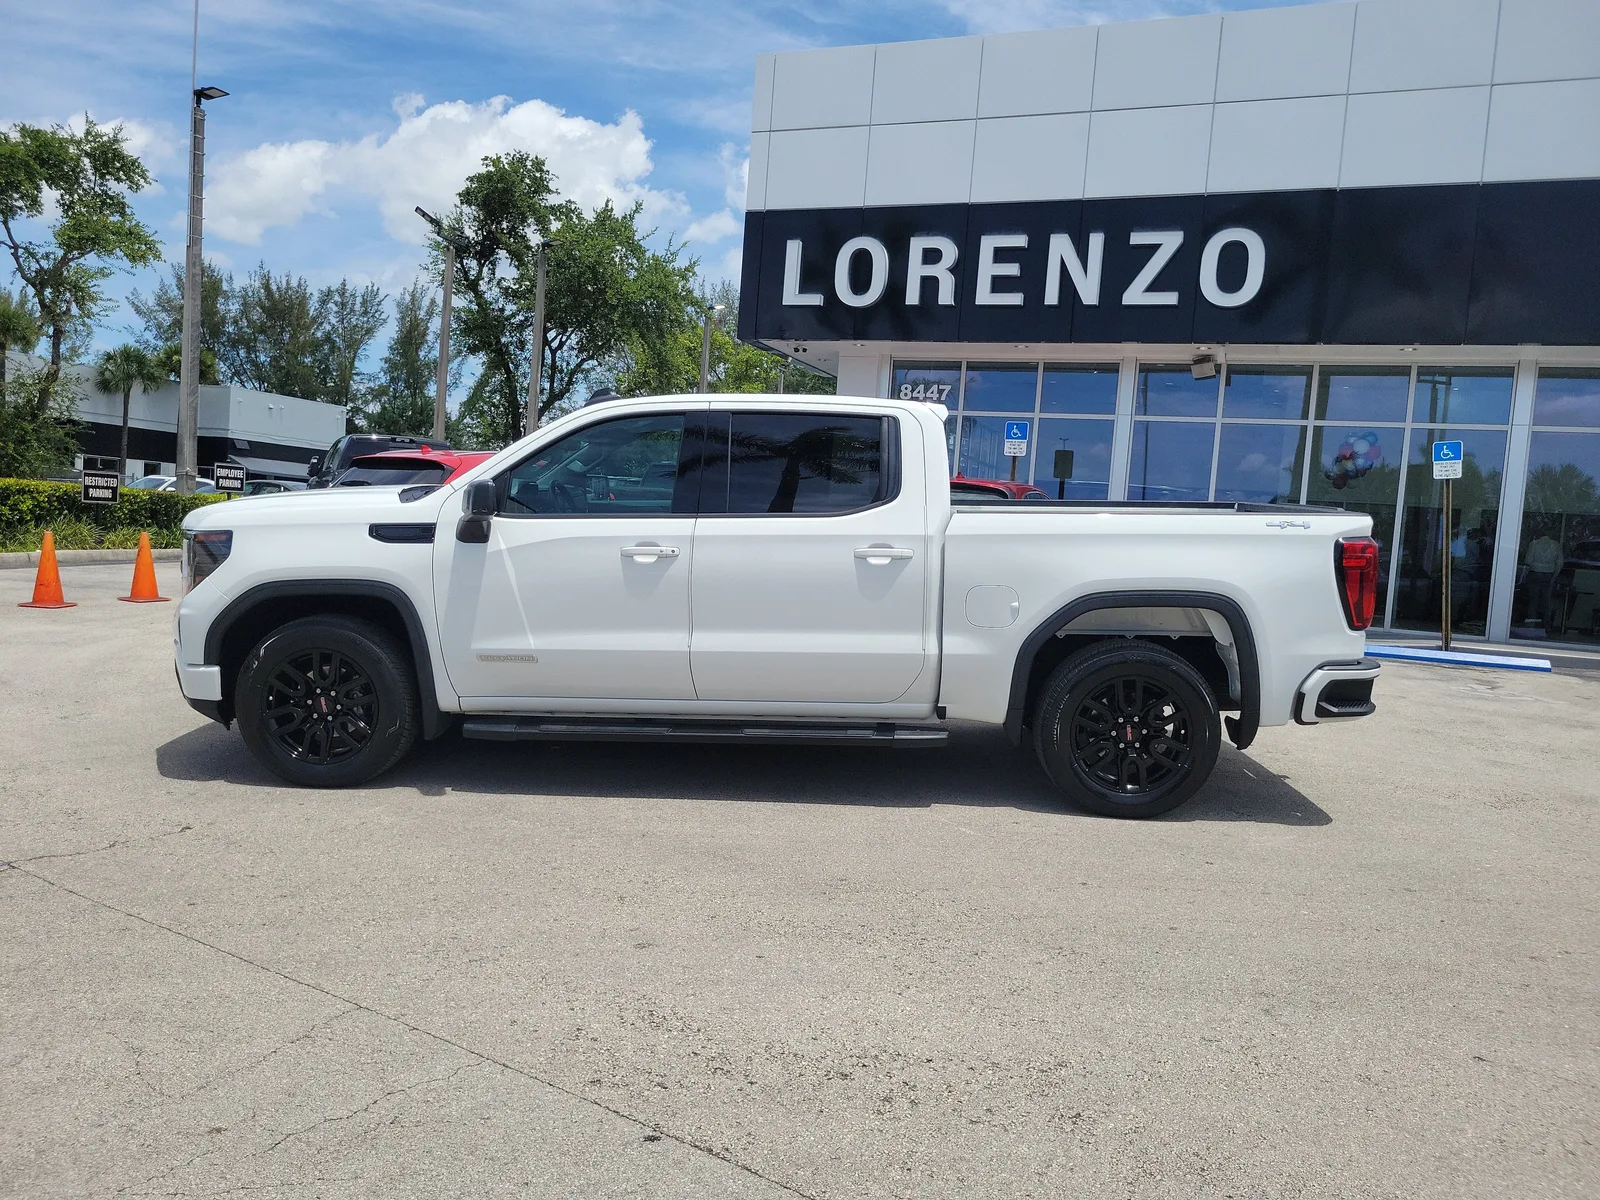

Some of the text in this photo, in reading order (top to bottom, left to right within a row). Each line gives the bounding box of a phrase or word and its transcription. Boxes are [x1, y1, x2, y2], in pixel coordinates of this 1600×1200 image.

[782, 227, 1266, 307] LORENZO
[900, 384, 952, 400] 8447
[217, 468, 244, 478] EMPLOYEE
[84, 476, 118, 487] RESTRICTED
[218, 479, 242, 488] PARKING
[88, 489, 112, 498] PARKING
